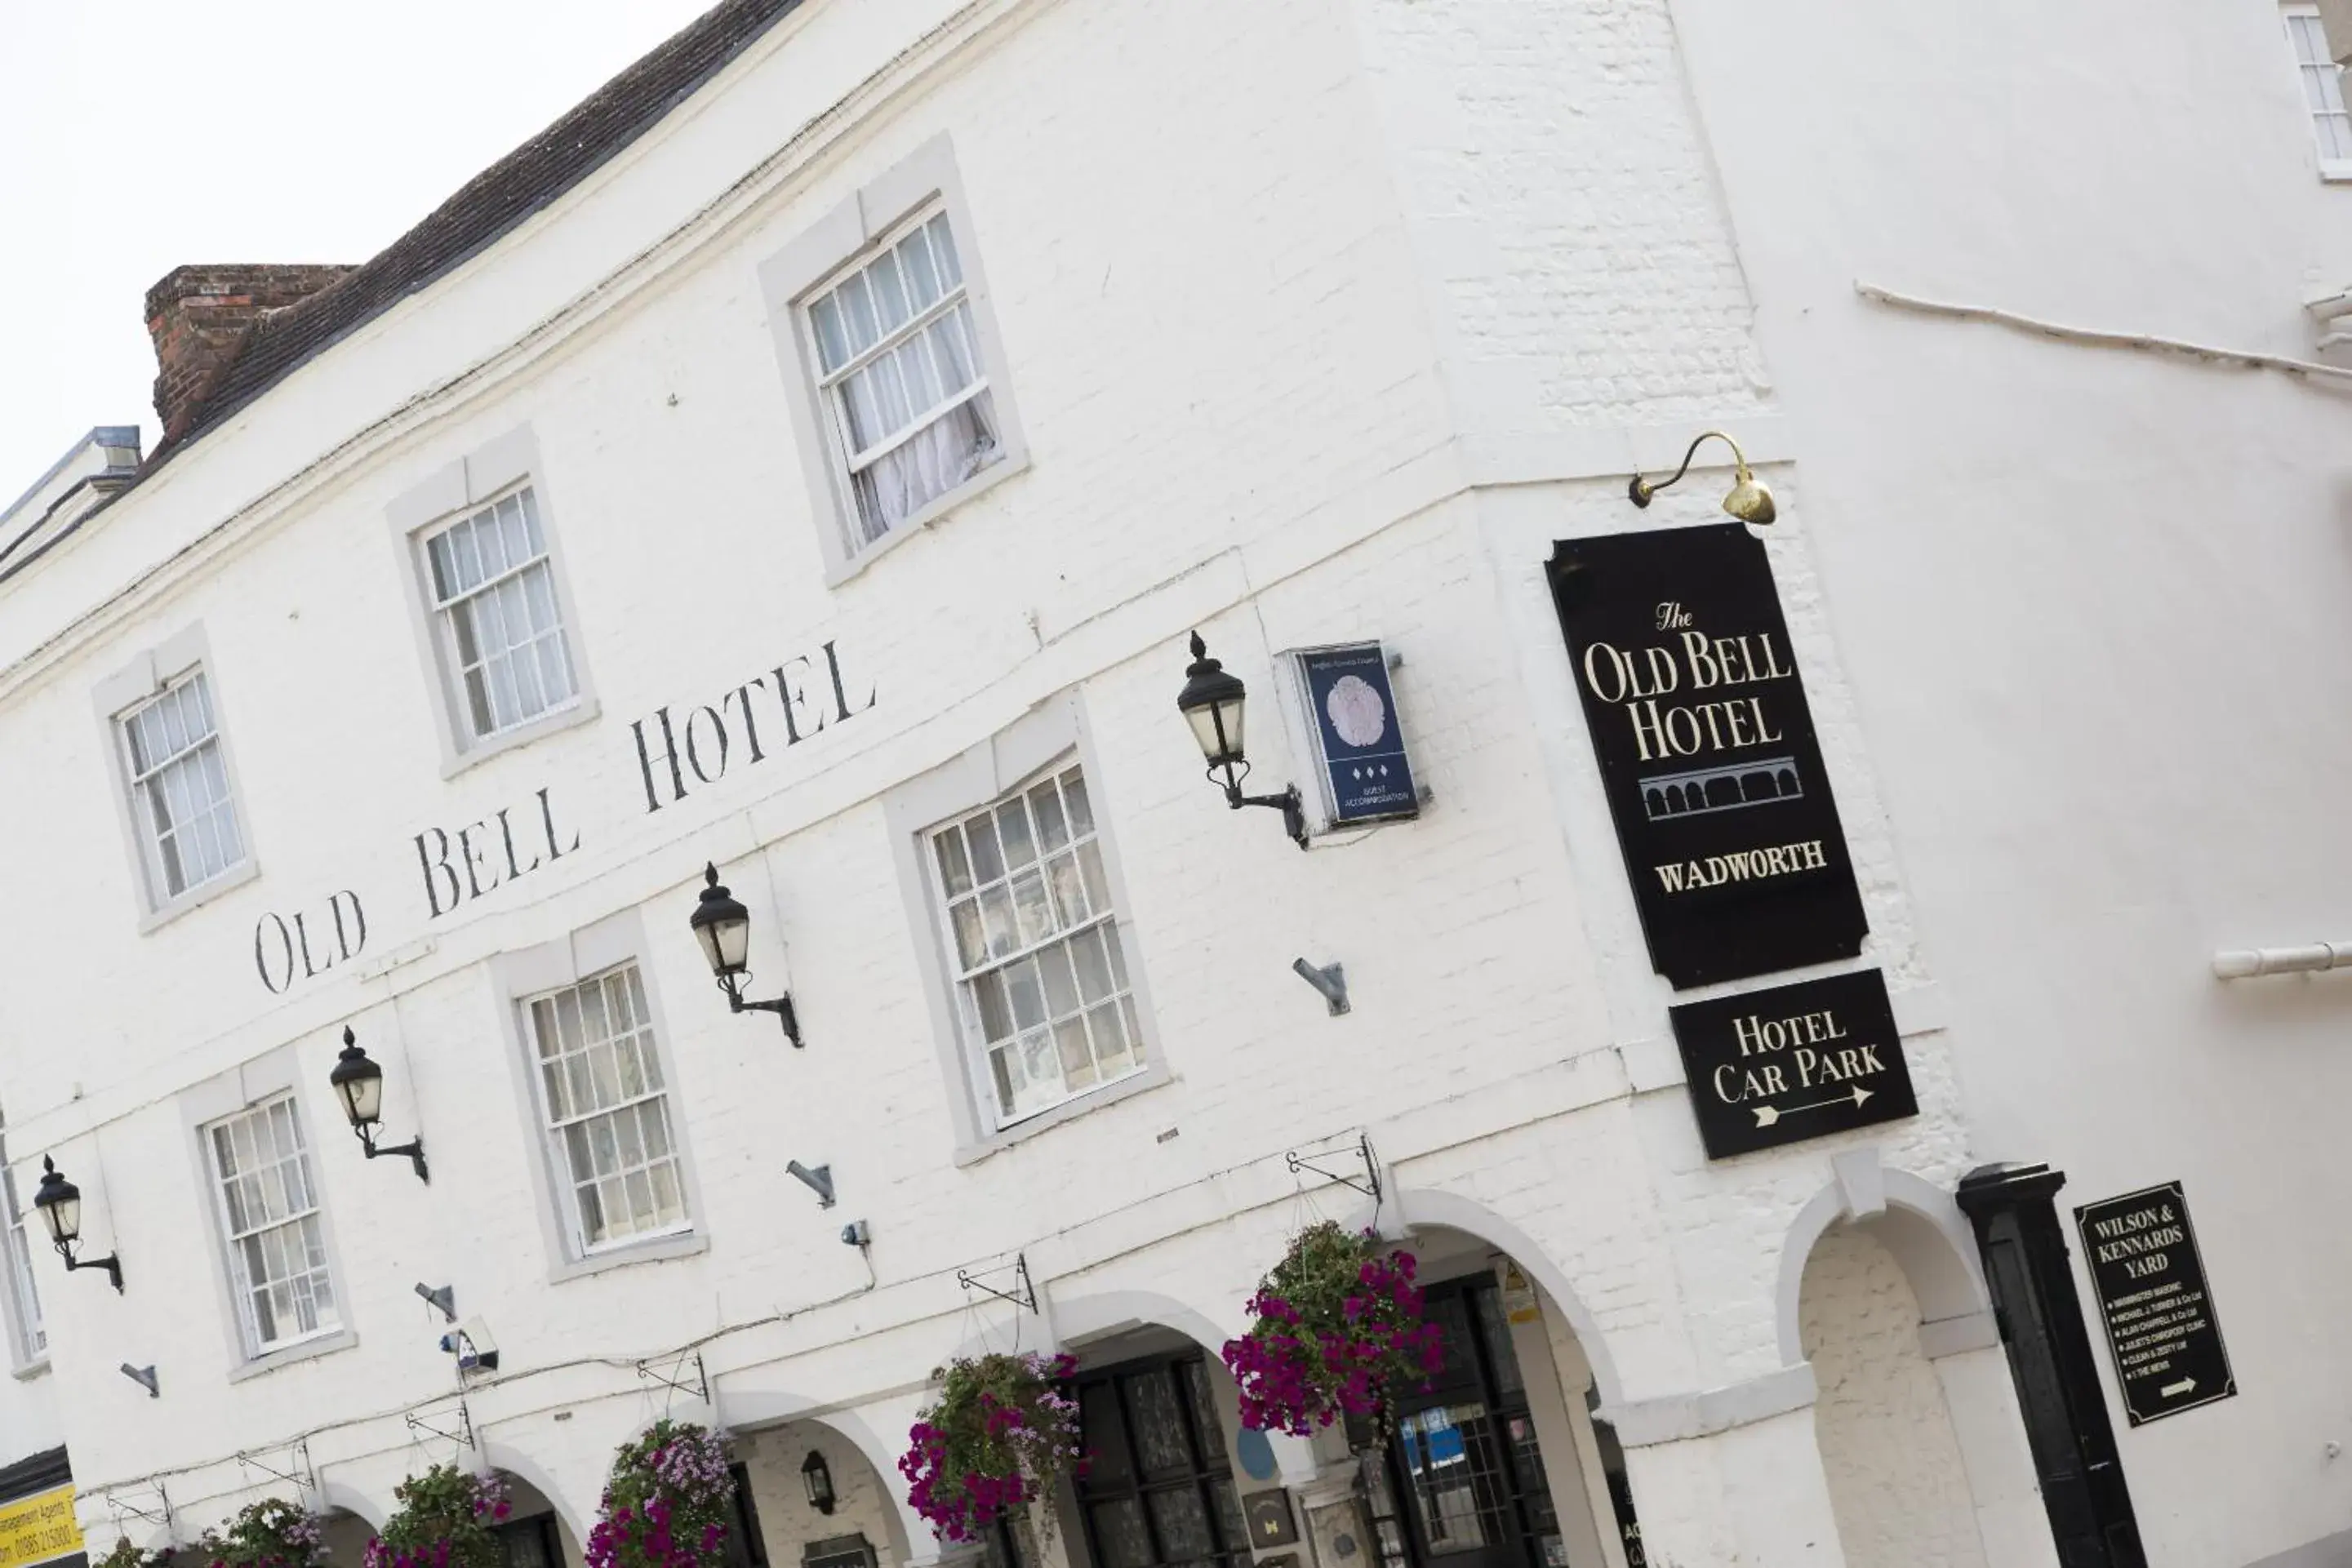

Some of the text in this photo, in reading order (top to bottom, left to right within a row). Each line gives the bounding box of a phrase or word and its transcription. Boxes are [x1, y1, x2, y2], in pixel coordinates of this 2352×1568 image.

[1656, 602, 1693, 630] The
[1585, 629, 1791, 704] OLD BELL
[1626, 698, 1783, 761] HOTEL
[256, 640, 876, 994] OLD BELL HOTEL
[1655, 841, 1827, 892] WADWORTH
[1733, 1011, 1847, 1056] HOTEL
[1714, 1045, 1885, 1104] CAR PARK
[2095, 1204, 2175, 1238] WILSON &
[2097, 1225, 2183, 1263] KENNARDS
[2125, 1253, 2168, 1278] YARD
